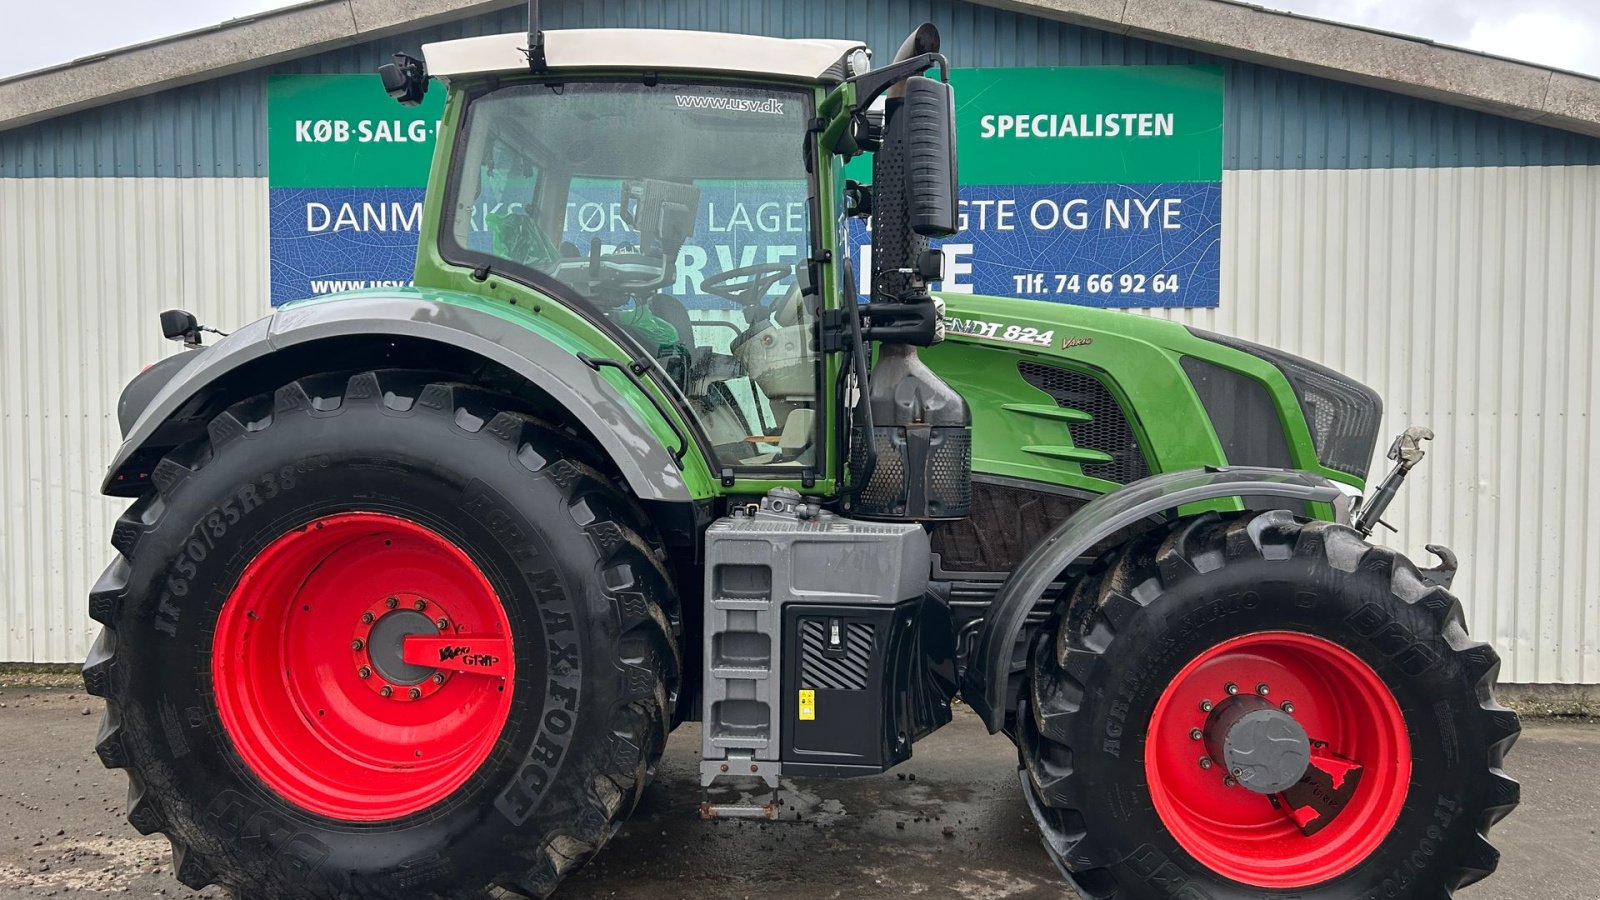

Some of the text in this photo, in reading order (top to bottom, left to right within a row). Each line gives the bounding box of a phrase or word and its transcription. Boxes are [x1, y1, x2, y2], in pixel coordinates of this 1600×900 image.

[675, 95, 784, 115] www.usv.dk
[980, 113, 1174, 138] SPECIALISTEN
[709, 202, 811, 232] LAGE
[1030, 198, 1088, 230] OG
[1105, 198, 1182, 230] NYE
[1013, 273, 1179, 294] Tlf. 74 66 92 64
[1003, 325, 1055, 348] 824
